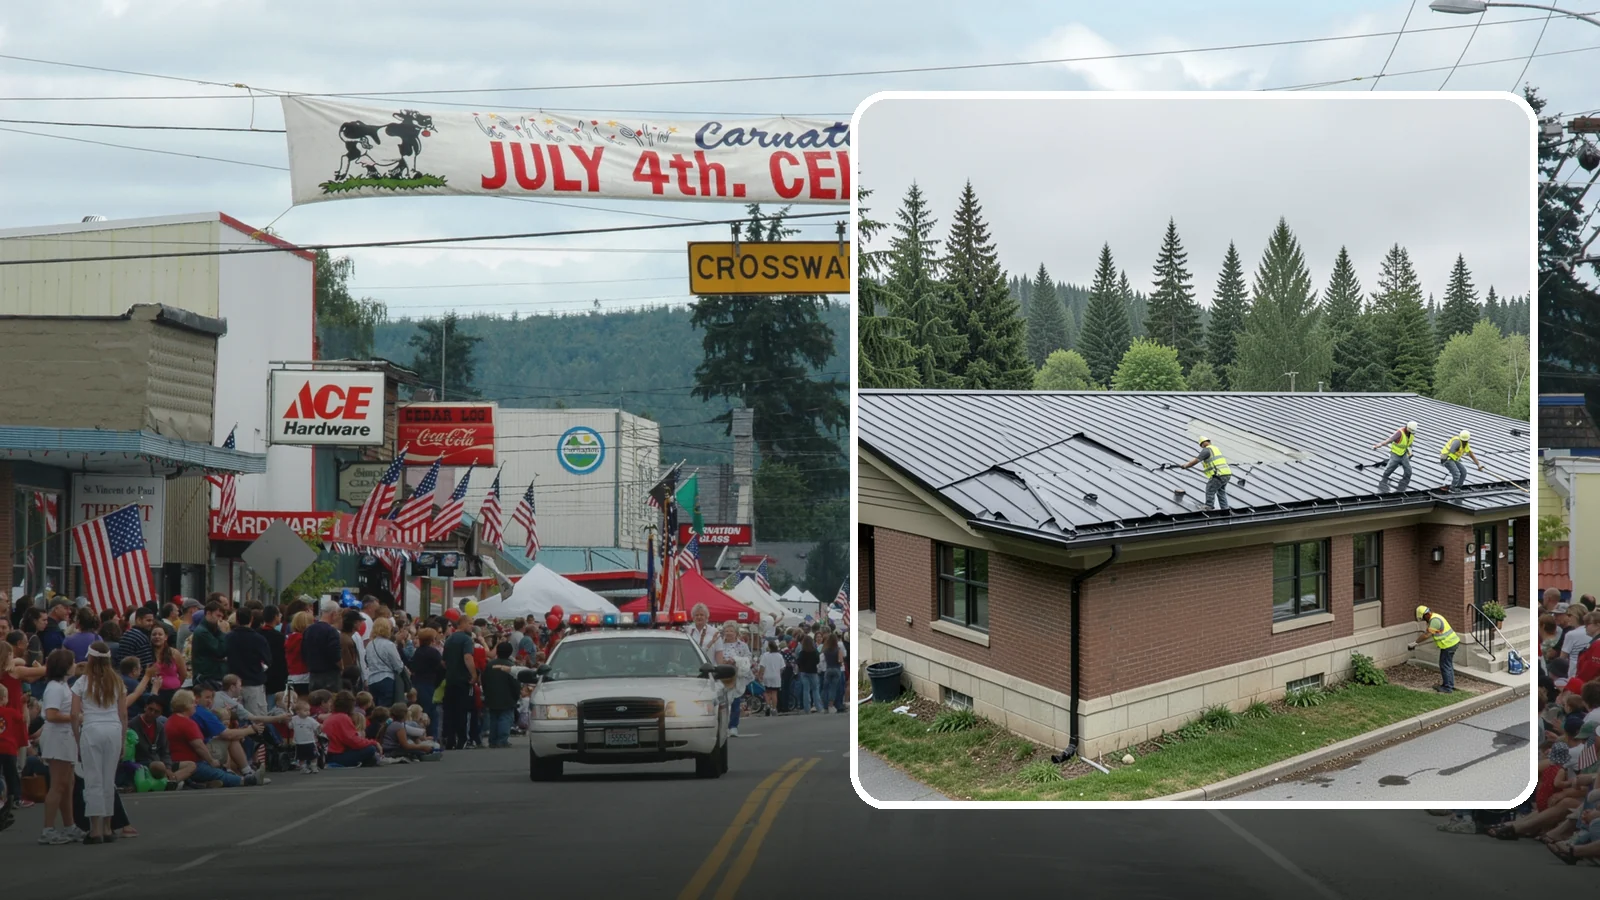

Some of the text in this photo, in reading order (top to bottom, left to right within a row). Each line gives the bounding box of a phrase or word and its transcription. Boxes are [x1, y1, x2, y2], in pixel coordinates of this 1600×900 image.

[481, 141, 604, 192] JULY
[632, 150, 746, 197] 4th.
[697, 254, 850, 280] CROSSWA
[283, 380, 373, 420] ACE
[406, 409, 485, 422] CEDAR LOG
[283, 421, 371, 436] Hardware
[416, 428, 477, 447] Coca-Cola
[353, 467, 386, 480] Simpl
[83, 485, 155, 495] St. Vincent de Paul
[81, 503, 153, 521] THRT
[688, 527, 741, 535] CRNATION
[699, 535, 730, 543] GLASS
